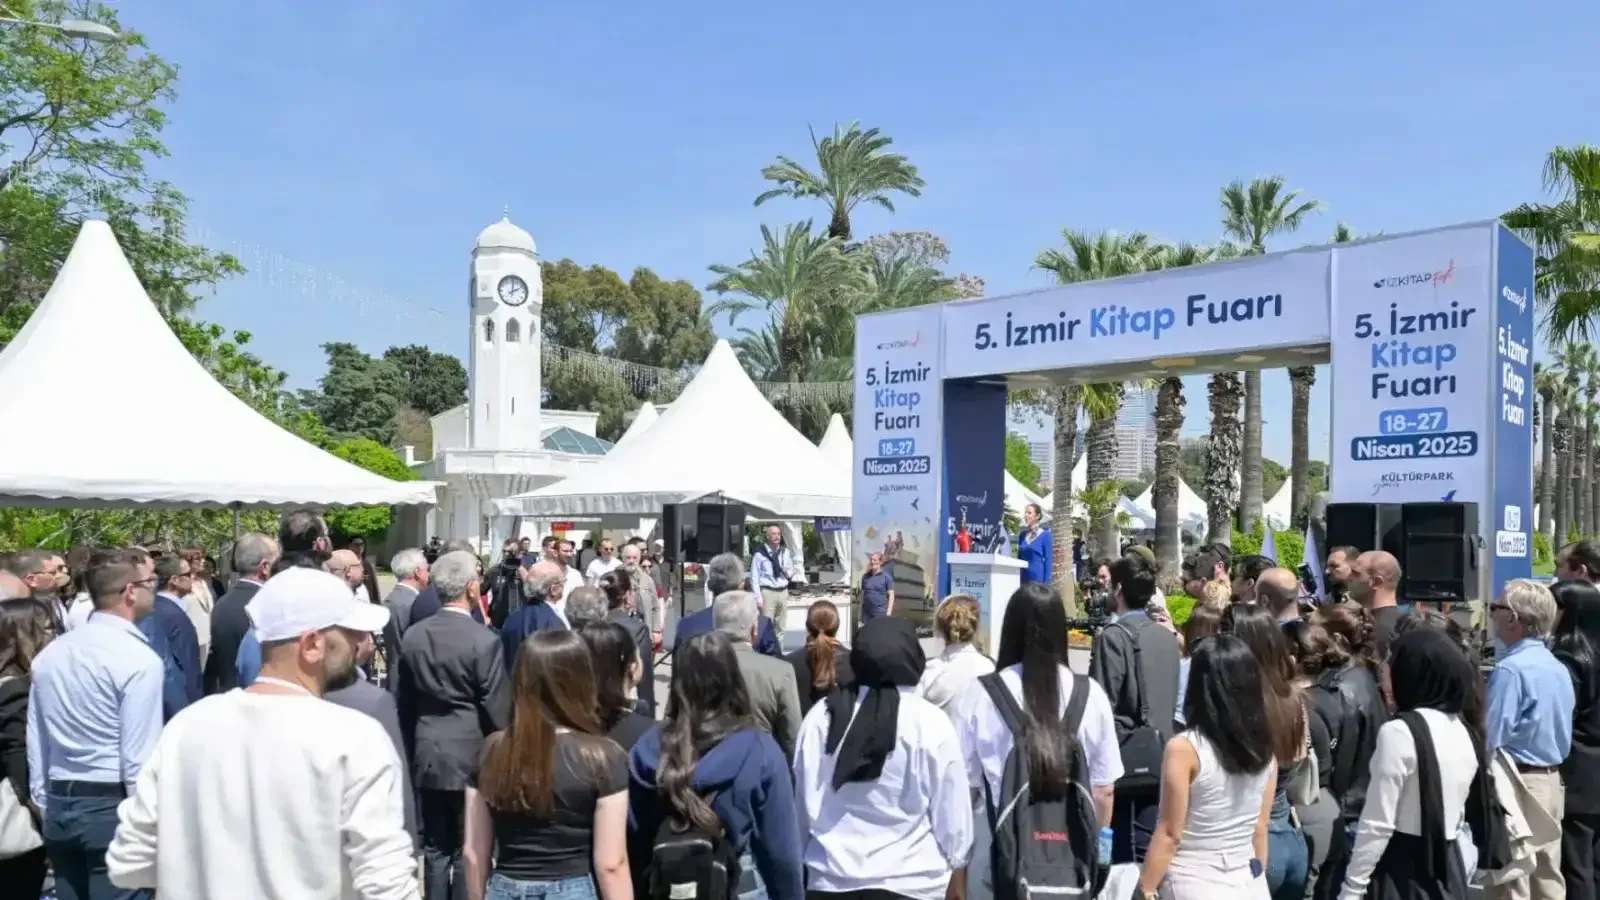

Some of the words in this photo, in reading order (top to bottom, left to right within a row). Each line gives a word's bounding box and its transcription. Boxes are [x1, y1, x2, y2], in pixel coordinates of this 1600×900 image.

[975, 323, 998, 350] 5.
[1005, 311, 1081, 347] İzmir
[1089, 304, 1175, 339] Kitap
[1186, 293, 1282, 327] Fuarı
[1354, 313, 1381, 339] 5.
[1390, 300, 1476, 336] İzmir
[1371, 340, 1457, 371] Kitap
[1507, 323, 1529, 366] İzmir
[865, 367, 881, 386] 5.
[885, 360, 931, 385] İzmir
[1371, 372, 1456, 400] Fuarı
[874, 388, 921, 411] Kitap
[874, 411, 921, 431] Fuarı
[1383, 411, 1443, 433] 18-27
[881, 440, 913, 456] 18-27
[1357, 439, 1414, 459] Nisan
[1418, 435, 1473, 456] 2025
[866, 460, 897, 474] Nisan
[899, 458, 929, 473] 2025
[1380, 471, 1455, 483] KÜLTÜRPARK
